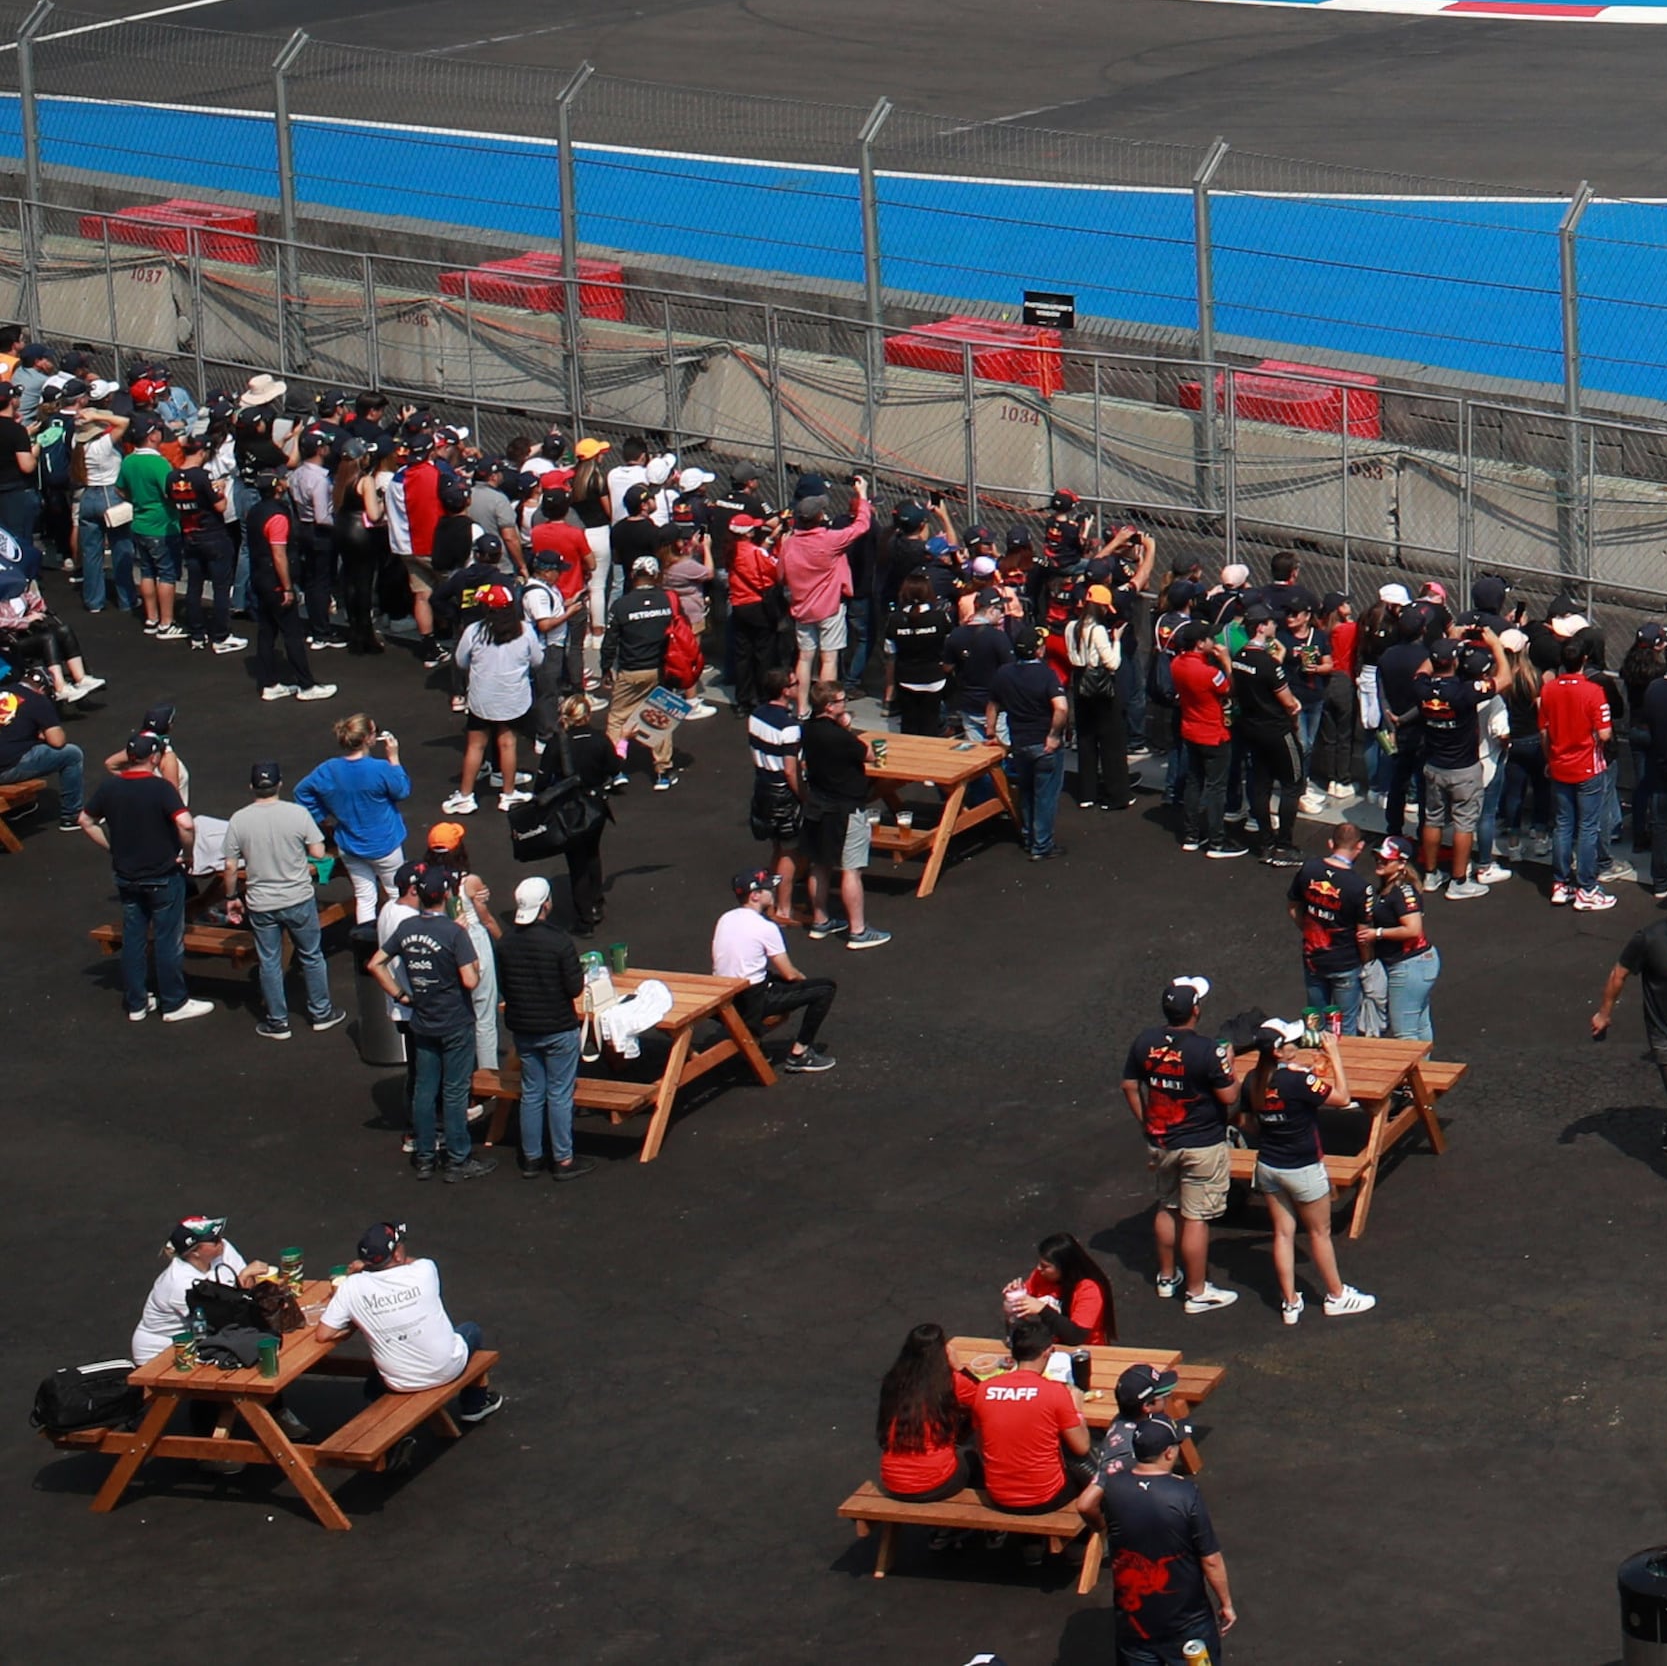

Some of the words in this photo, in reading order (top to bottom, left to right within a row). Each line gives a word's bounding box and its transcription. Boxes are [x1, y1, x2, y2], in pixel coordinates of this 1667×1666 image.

[131, 267, 162, 284] 1037
[1000, 404, 1040, 426] 1034
[628, 607, 672, 621] PETRONAS
[362, 1285, 422, 1310] Mexican
[984, 1386, 1039, 1401] STAFF
